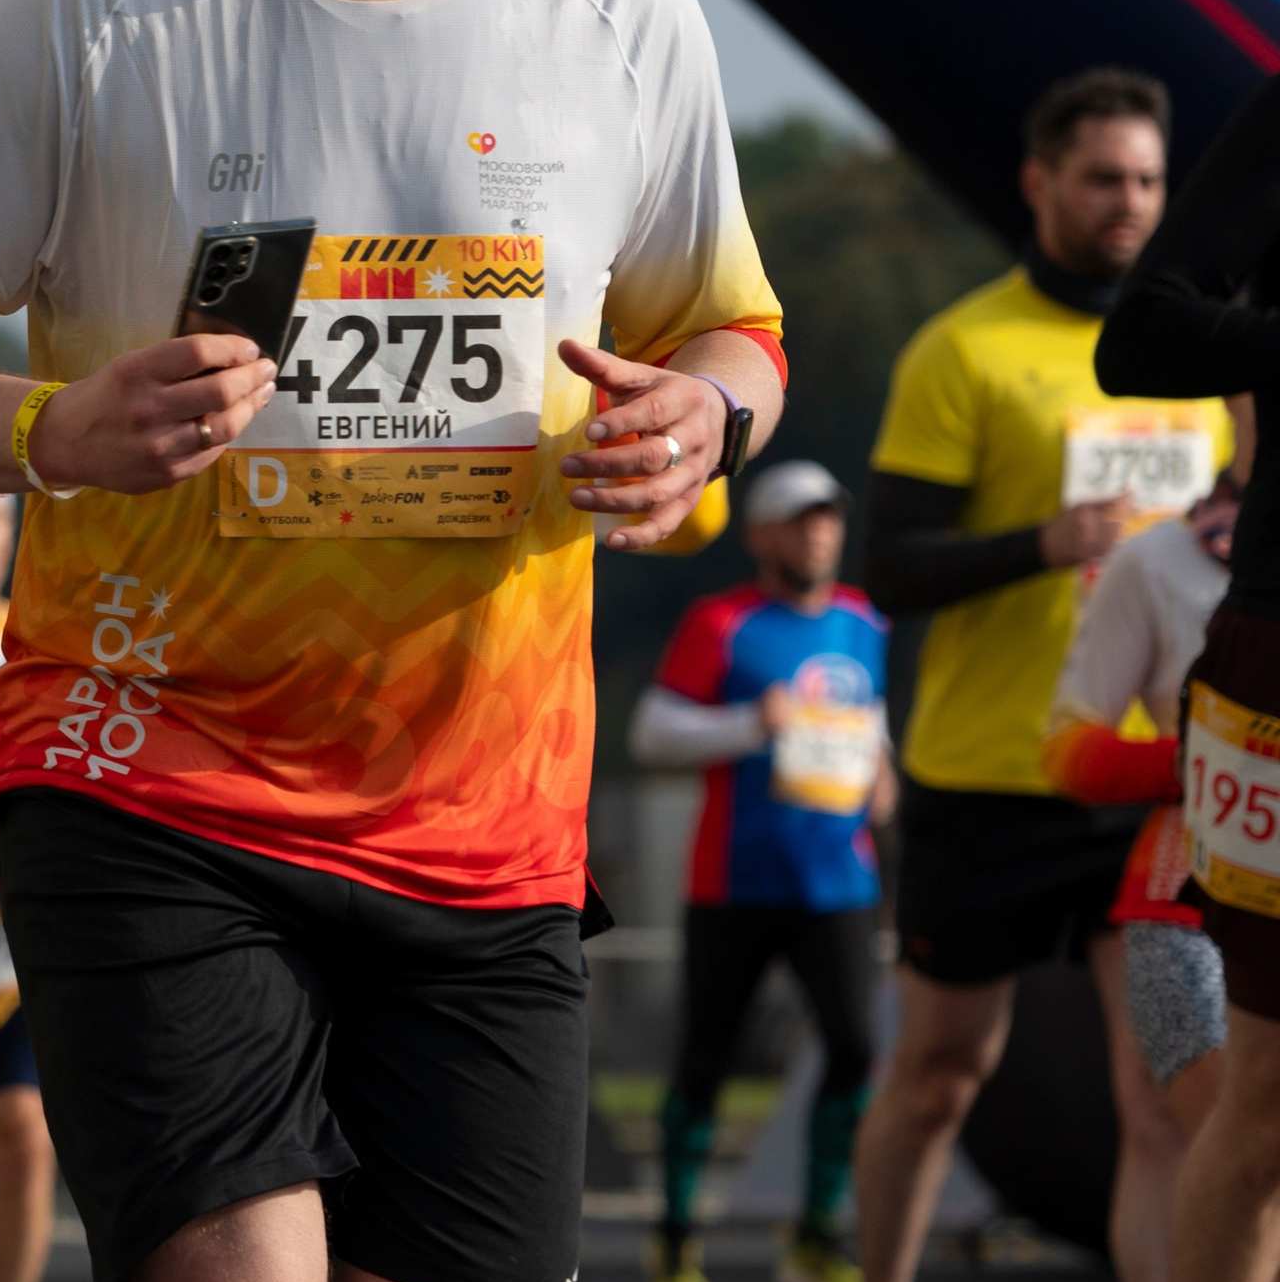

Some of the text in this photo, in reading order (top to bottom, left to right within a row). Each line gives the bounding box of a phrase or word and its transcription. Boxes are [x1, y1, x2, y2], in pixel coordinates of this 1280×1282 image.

[207, 152, 266, 192] GRi
[478, 160, 565, 174] МОСКОВСКИЙ
[479, 173, 543, 187] МАРАФОН
[480, 186, 535, 200] MOSCOW
[481, 199, 549, 213] MARATHON
[458, 239, 486, 262] 10
[276, 314, 503, 404] 4275
[317, 409, 452, 439] ЕВГЕНИЙ
[248, 456, 288, 507] D
[258, 516, 312, 525] ФУТБОЛКА
[1192, 755, 1280, 843] 195
